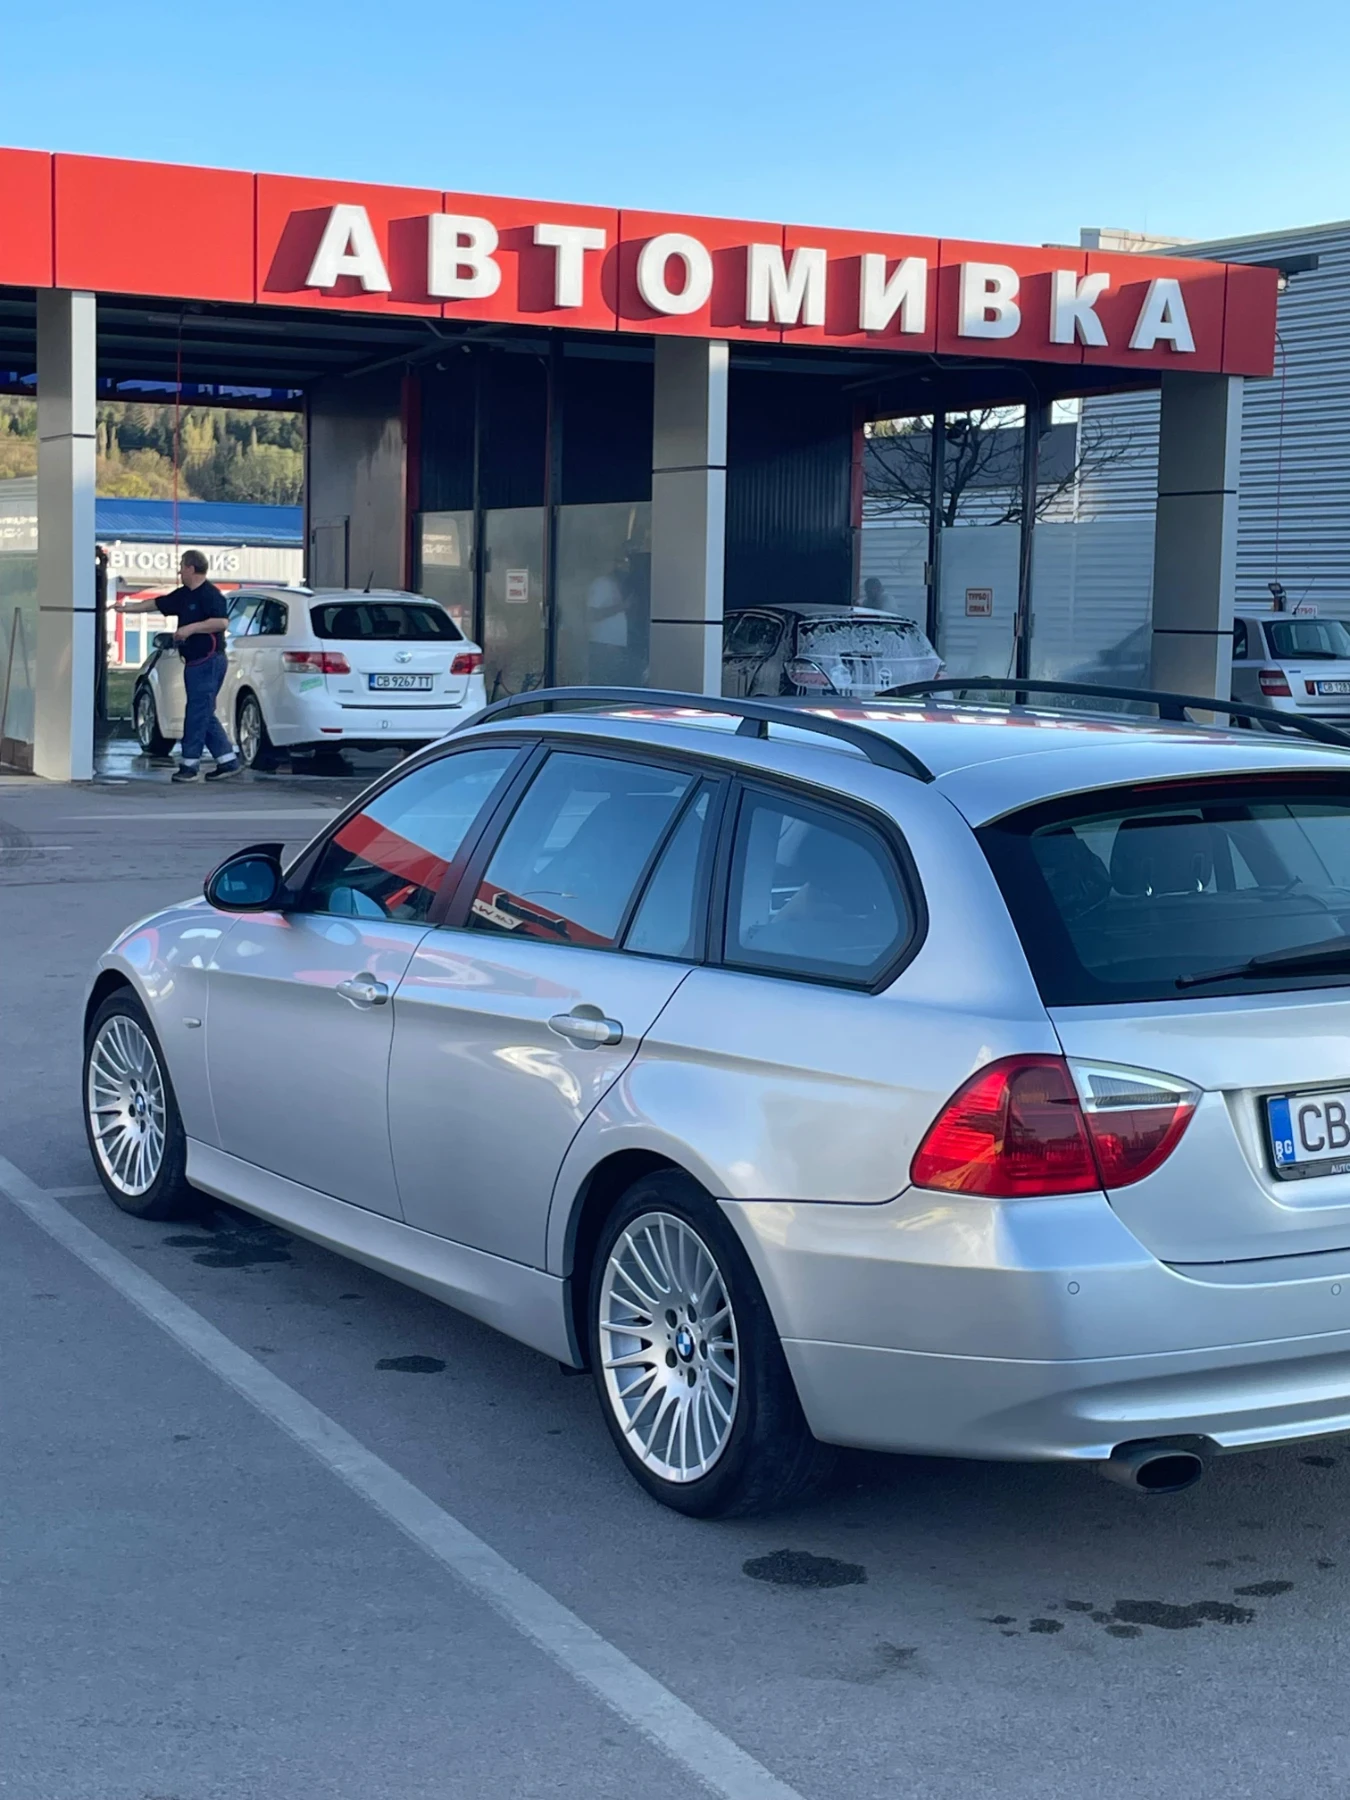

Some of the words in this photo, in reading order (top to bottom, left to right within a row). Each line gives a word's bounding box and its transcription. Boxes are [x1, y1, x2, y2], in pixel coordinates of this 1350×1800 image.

[305, 203, 1196, 354] АВТОМИВКА
[392, 675, 415, 688] 9267
[1274, 1139, 1293, 1155] BG
[1298, 1101, 1350, 1152] CB
